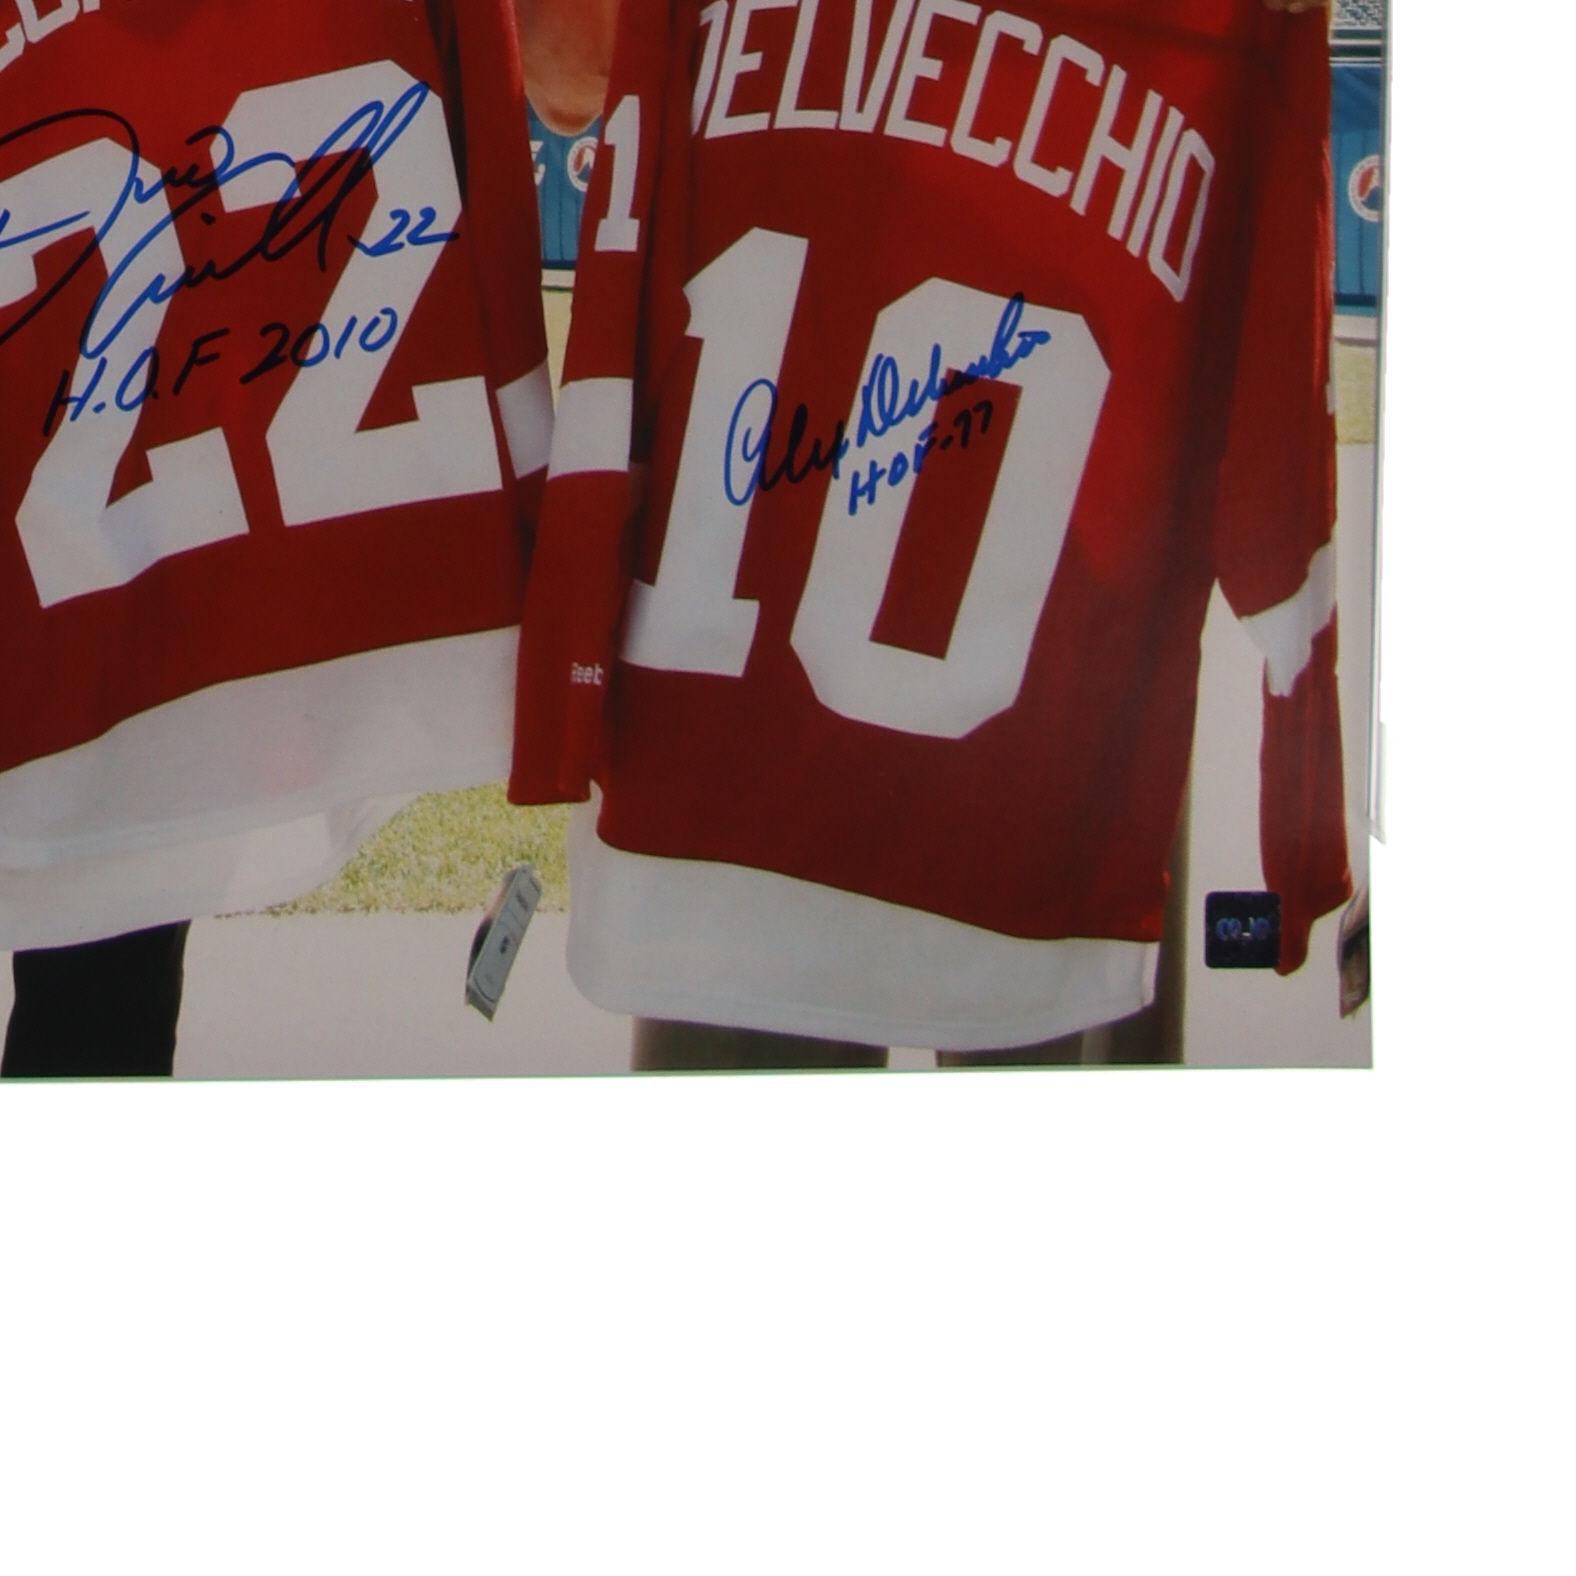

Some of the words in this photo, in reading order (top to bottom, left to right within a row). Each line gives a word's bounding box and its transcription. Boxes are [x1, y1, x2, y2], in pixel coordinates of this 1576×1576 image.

[14, 59, 504, 609] 22
[239, 307, 397, 385] 2010
[619, 226, 1112, 741] 10
